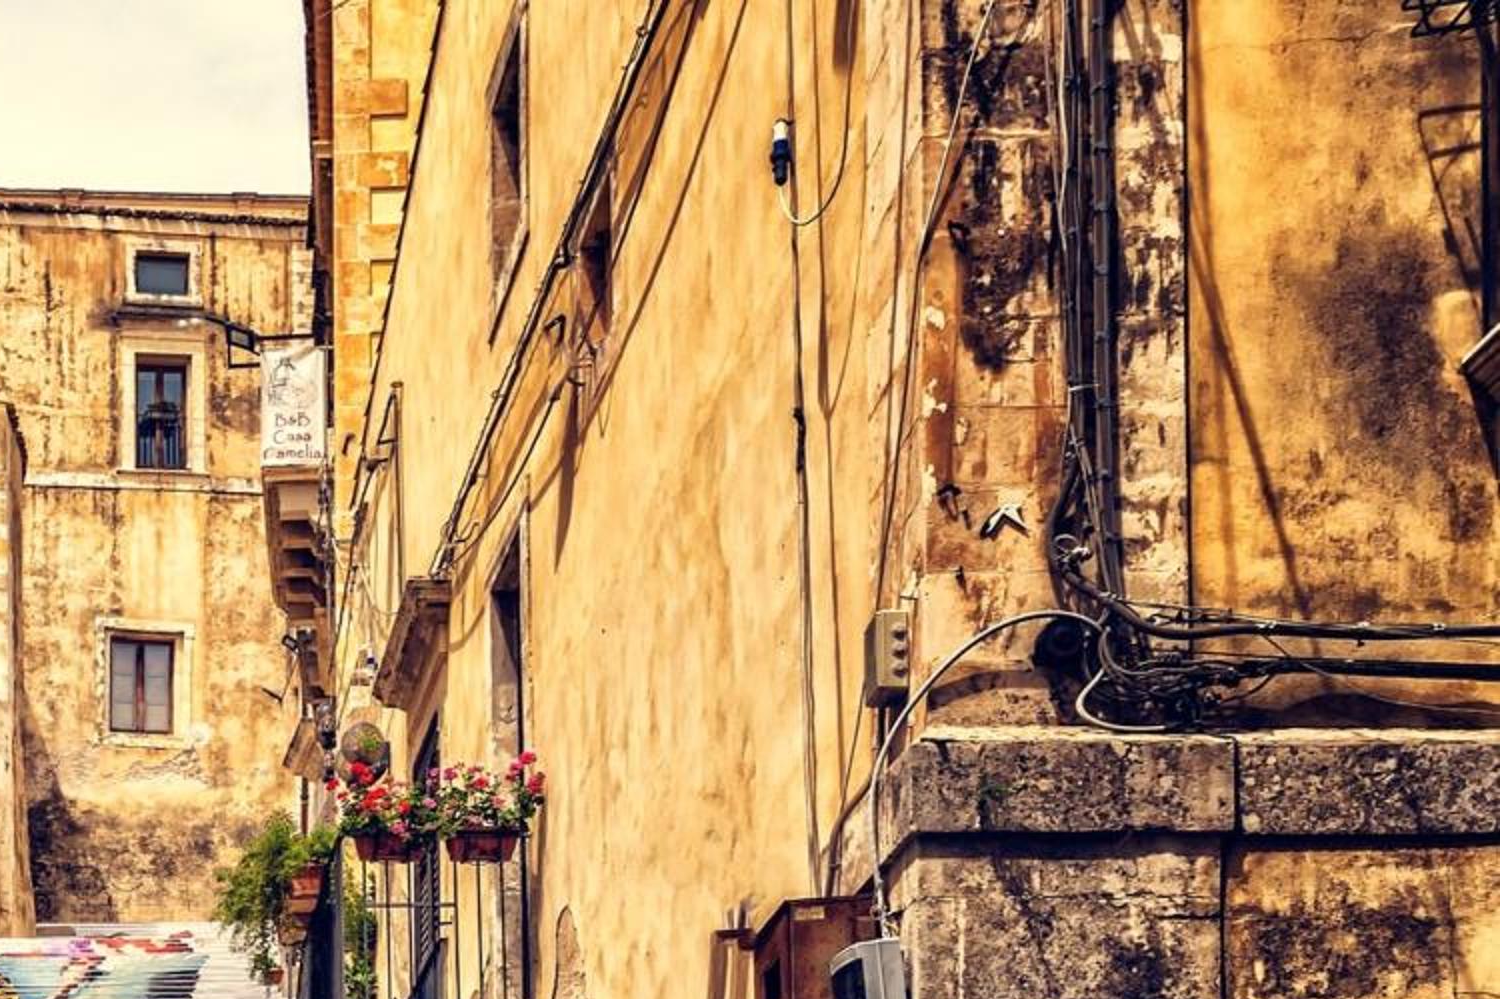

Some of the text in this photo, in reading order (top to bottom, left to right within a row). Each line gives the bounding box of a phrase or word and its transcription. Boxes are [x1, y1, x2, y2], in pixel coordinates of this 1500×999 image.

[274, 411, 311, 427] B&B
[273, 430, 312, 444] Casa
[263, 444, 322, 460] Camelia
